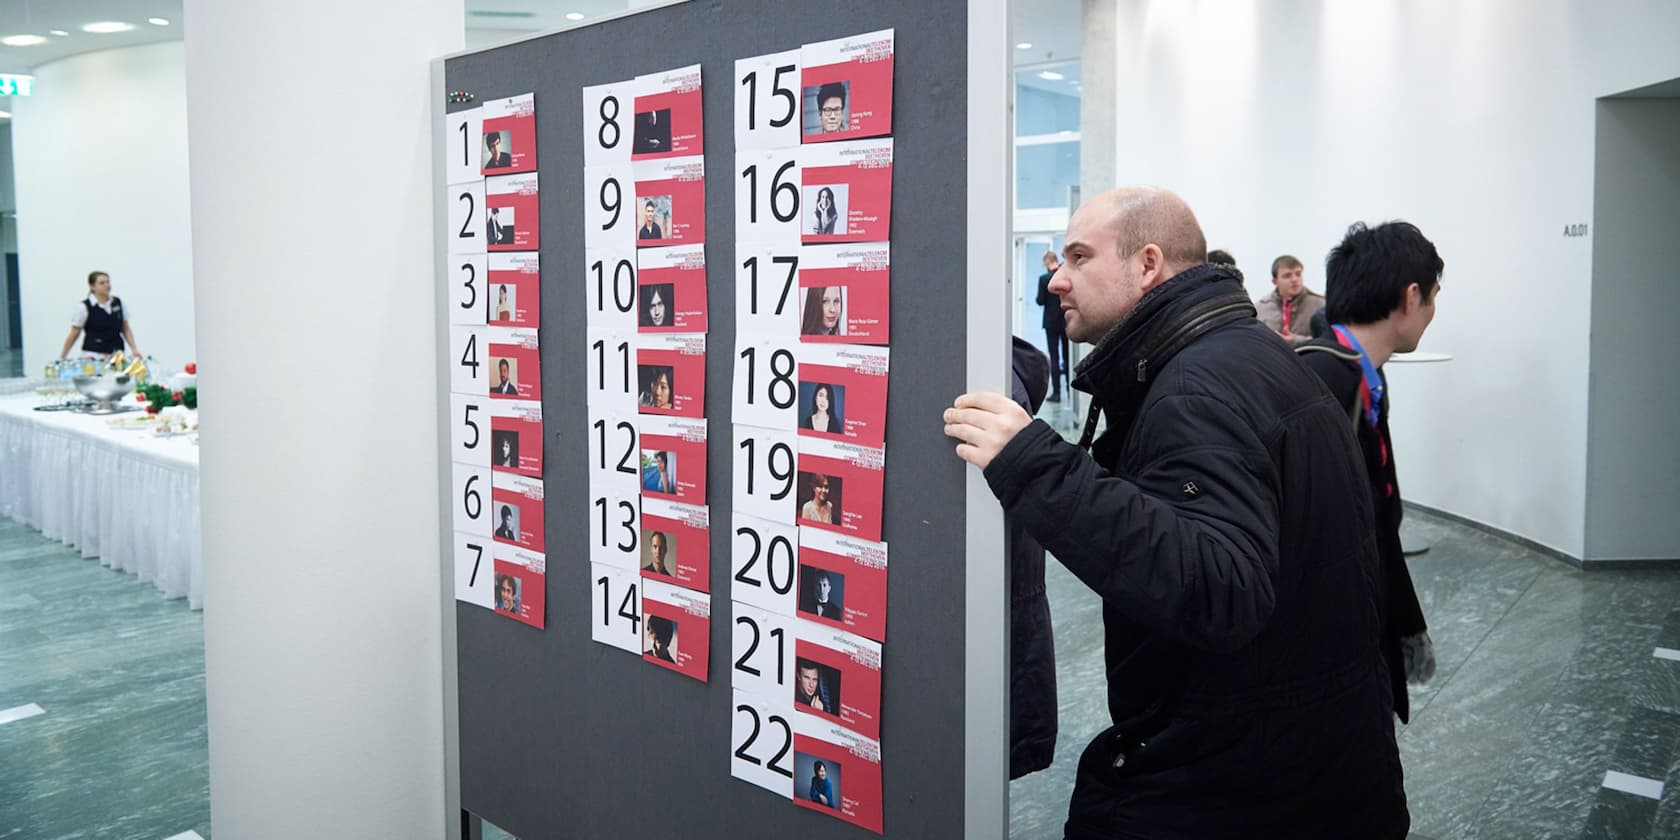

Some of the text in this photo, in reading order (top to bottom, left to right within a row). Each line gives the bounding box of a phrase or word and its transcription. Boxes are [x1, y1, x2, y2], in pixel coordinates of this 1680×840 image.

[598, 95, 621, 150] 8
[742, 64, 796, 131] 15
[459, 121, 469, 166] 1
[459, 192, 475, 238] 2
[599, 177, 622, 231] 9
[742, 160, 800, 224] 16
[461, 263, 476, 309] 3
[591, 259, 636, 313] 10
[743, 255, 799, 316] 17
[461, 334, 480, 379] 4
[593, 339, 629, 393] 11
[740, 347, 797, 410] 18
[463, 404, 479, 449] 5
[593, 419, 638, 475] 12
[740, 438, 795, 501] 19
[464, 475, 482, 520] 6
[595, 497, 637, 553] 13
[466, 543, 483, 588] 7
[734, 526, 795, 595] 20
[597, 576, 641, 635] 14
[734, 616, 784, 686] 21
[734, 704, 793, 779] 22
